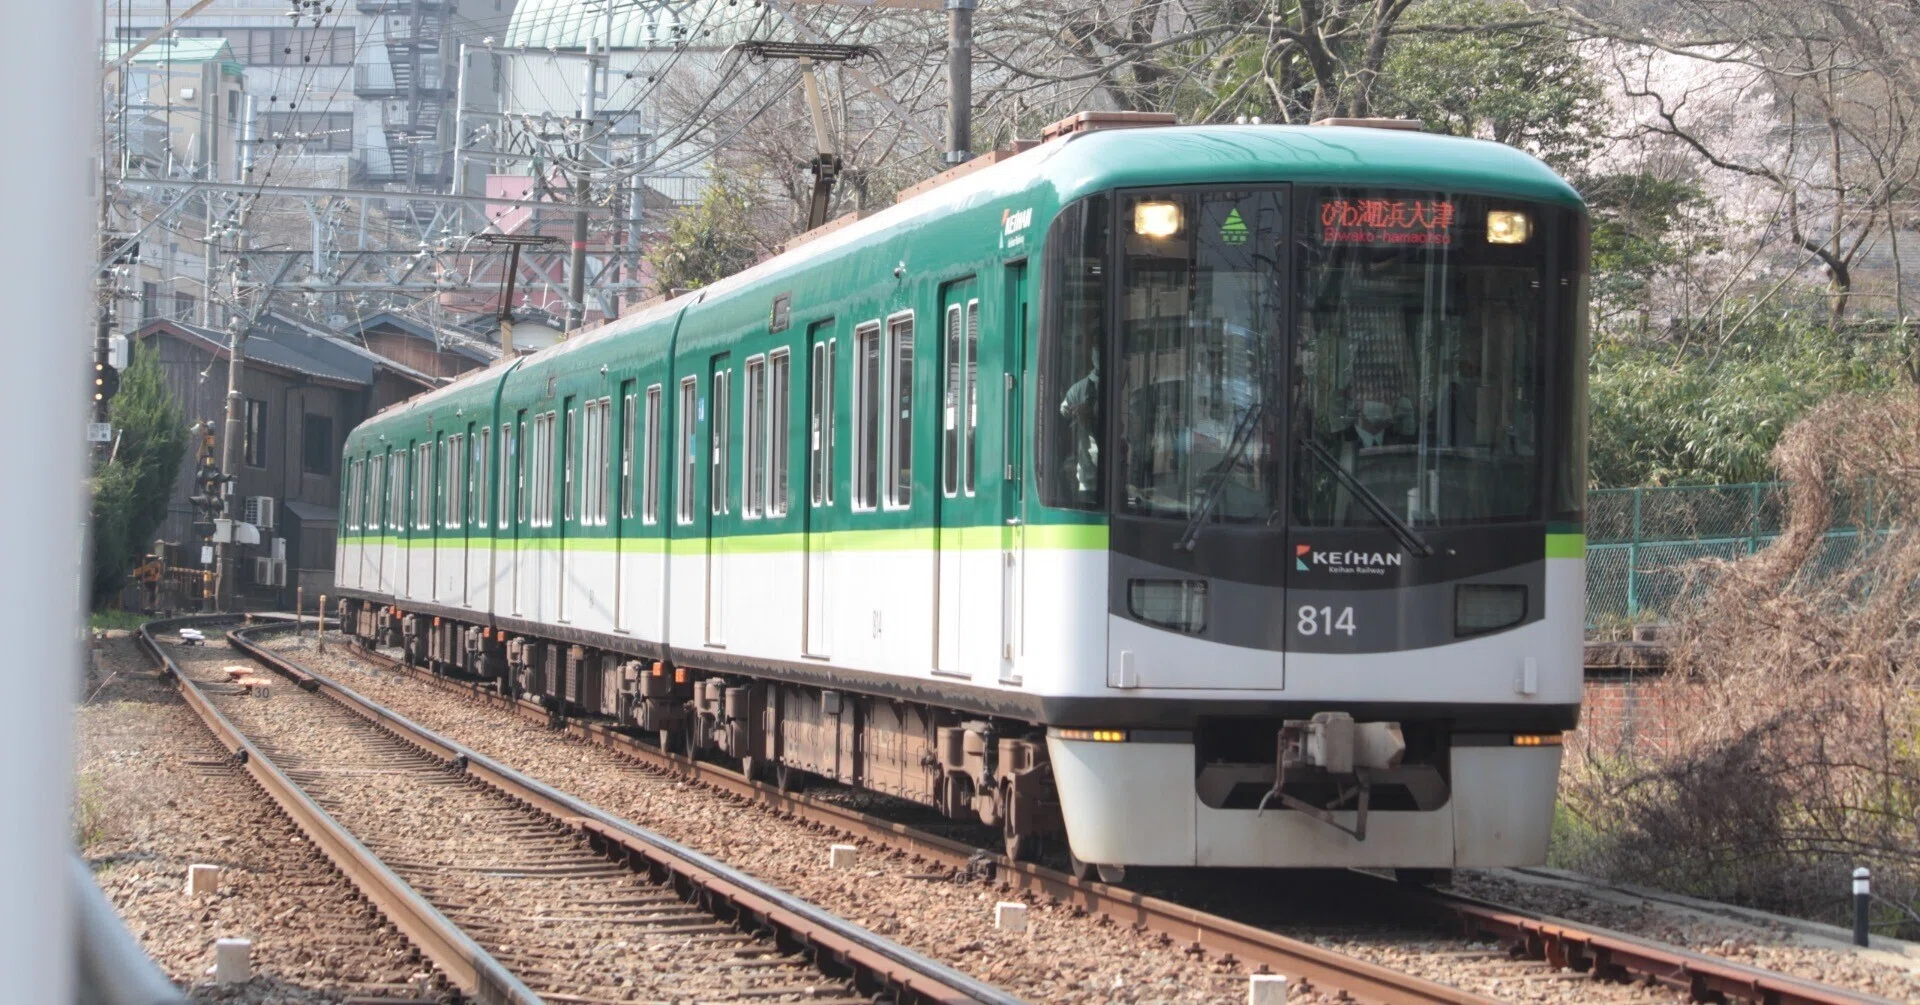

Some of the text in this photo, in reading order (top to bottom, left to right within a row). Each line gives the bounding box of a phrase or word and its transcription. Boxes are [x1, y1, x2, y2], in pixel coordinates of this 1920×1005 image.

[1321, 200, 1454, 228] びわ湖浜大津
[1312, 550, 1401, 566] KEIHAN
[1328, 566, 1386, 575] Keihan Railway
[1297, 605, 1357, 636] 814
[254, 686, 270, 699] 30
